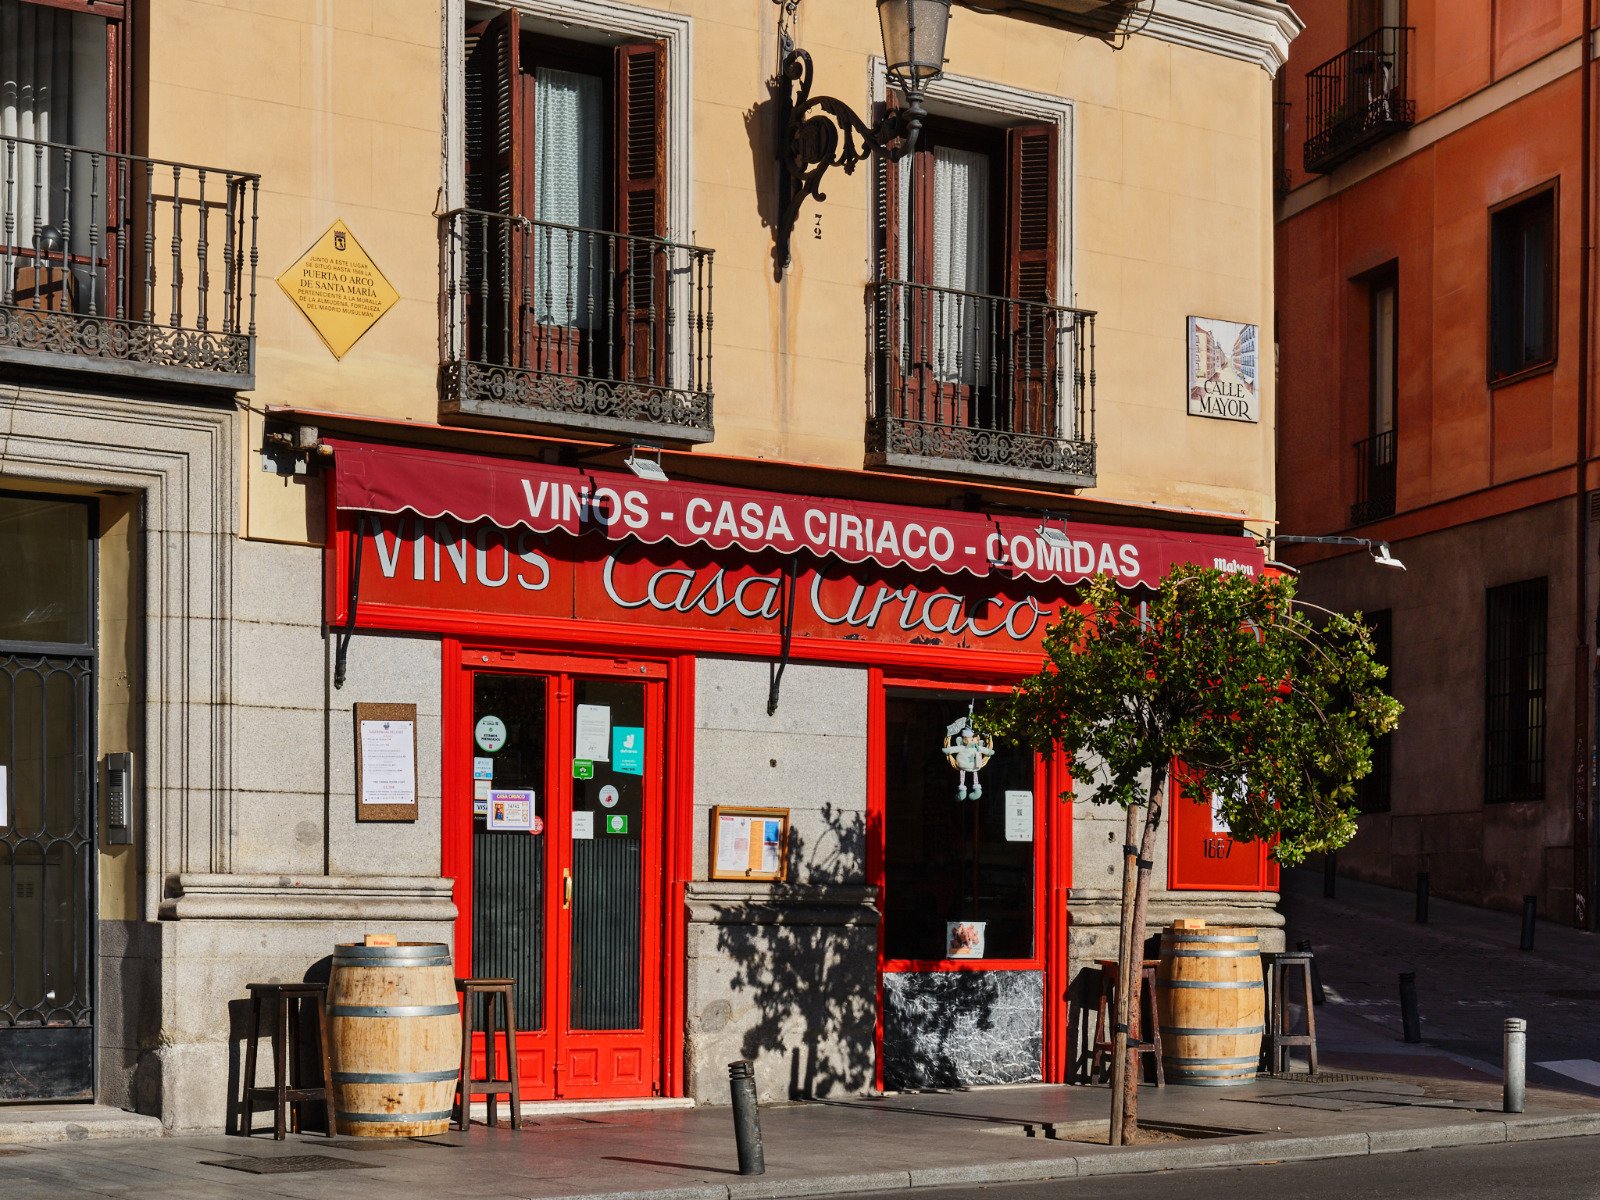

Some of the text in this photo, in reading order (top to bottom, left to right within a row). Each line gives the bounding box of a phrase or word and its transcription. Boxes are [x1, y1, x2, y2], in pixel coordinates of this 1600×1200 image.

[350, 262, 368, 270] LUGAR
[303, 269, 374, 287] PUERTA O ARCO
[298, 289, 341, 299] PERTENECIENTE
[356, 297, 382, 306] MURALLA
[300, 279, 377, 298] DE SANTA MARÍA
[319, 305, 341, 313] MADRID
[350, 302, 381, 312] FORTALEZA
[1204, 379, 1245, 399] CALLE
[1199, 395, 1252, 420] MAYOR
[521, 479, 649, 529] VINOS
[685, 497, 794, 541] CASA
[804, 508, 955, 561] CIRIACO
[986, 532, 1141, 578] COMIDAS
[1213, 557, 1254, 576] Mahou
[370, 514, 550, 591] VINOS
[602, 540, 782, 619] Casa
[810, 560, 1052, 640] Ciriaco
